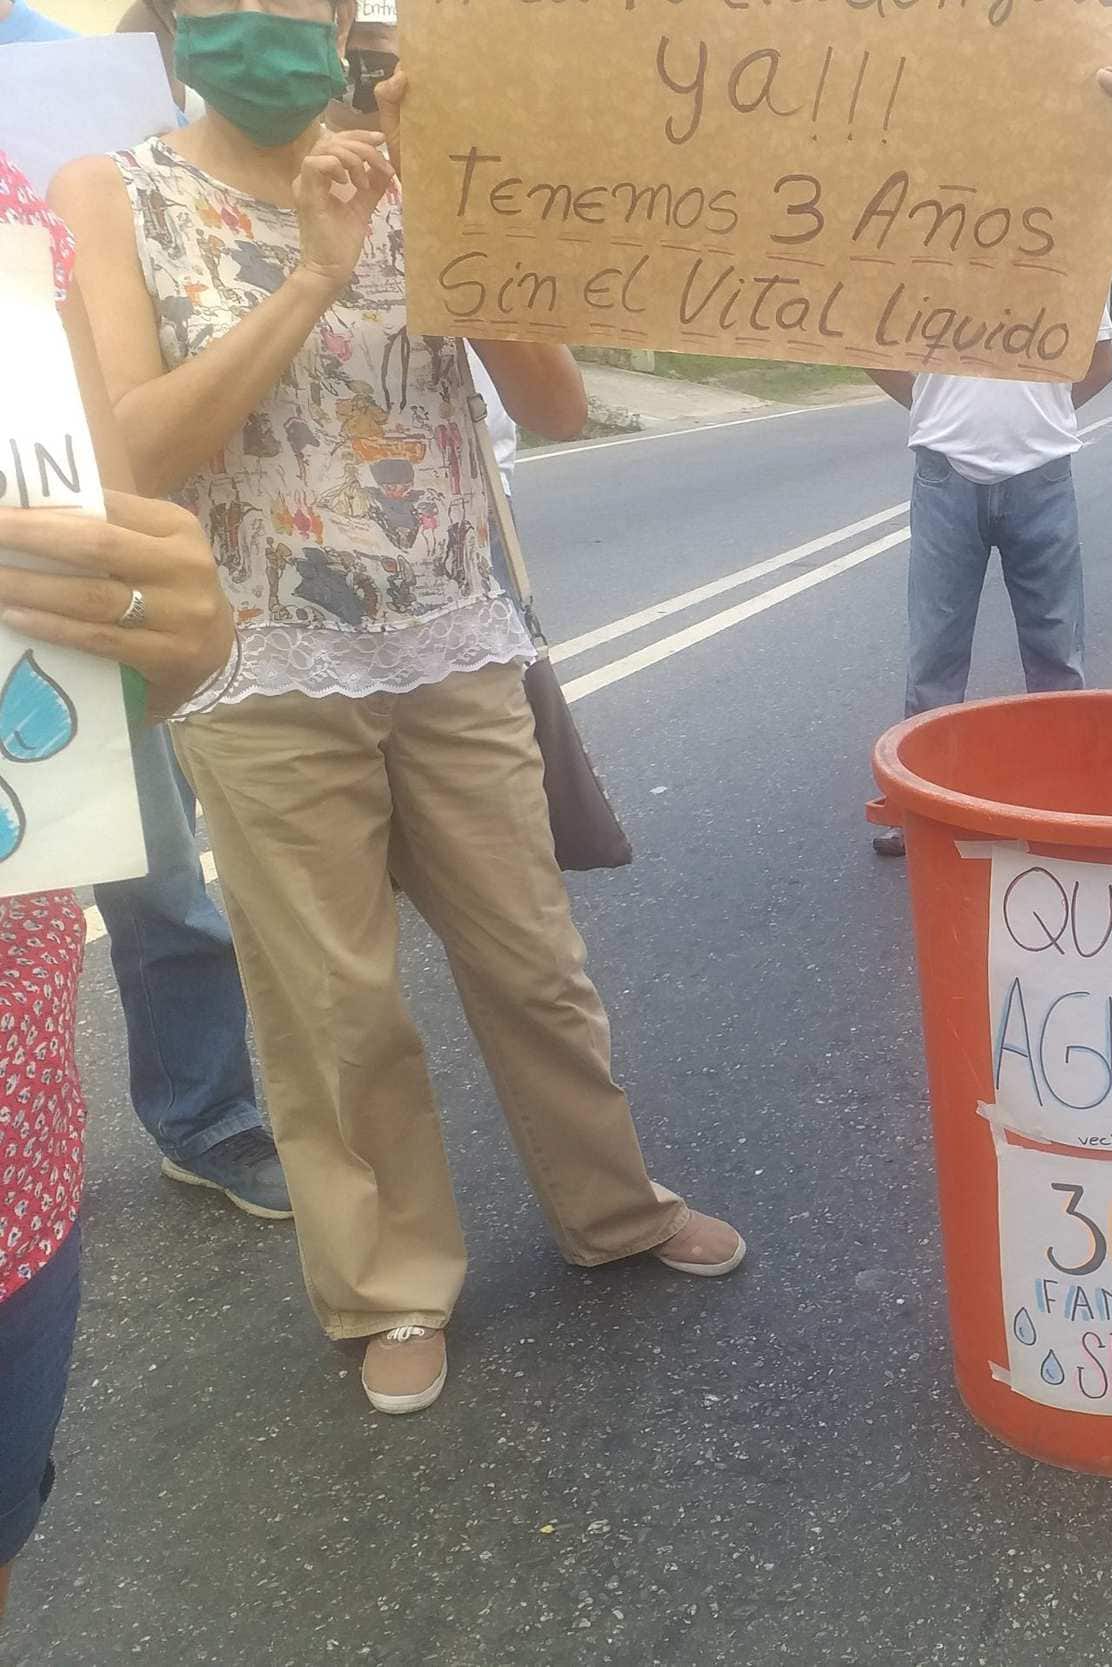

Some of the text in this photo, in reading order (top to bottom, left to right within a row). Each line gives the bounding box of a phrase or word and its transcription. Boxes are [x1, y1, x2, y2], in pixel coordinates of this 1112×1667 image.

[770, 174, 825, 245] 3
[849, 169, 1056, 256] Años
[437, 251, 559, 320] Sin
[679, 258, 844, 338] Vital
[0, 433, 81, 509] IN
